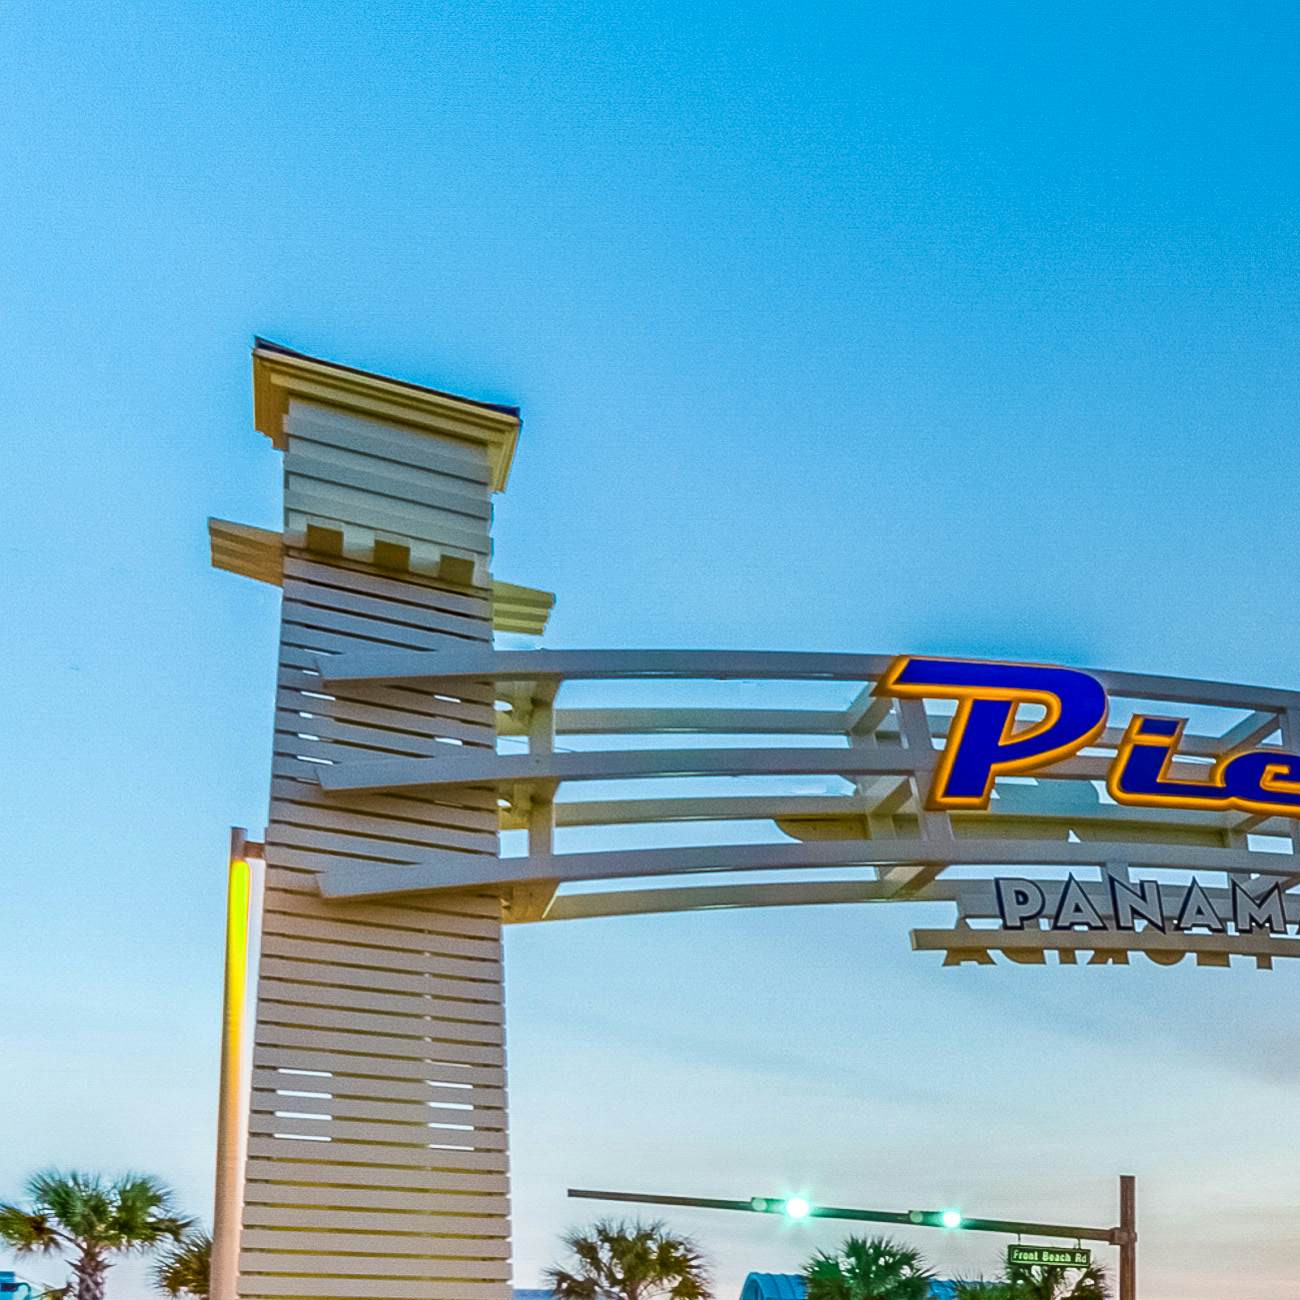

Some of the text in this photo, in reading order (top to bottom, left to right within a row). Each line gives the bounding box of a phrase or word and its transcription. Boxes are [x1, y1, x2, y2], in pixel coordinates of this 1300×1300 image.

[1013, 1249, 1086, 1262] Front Beach Rd
